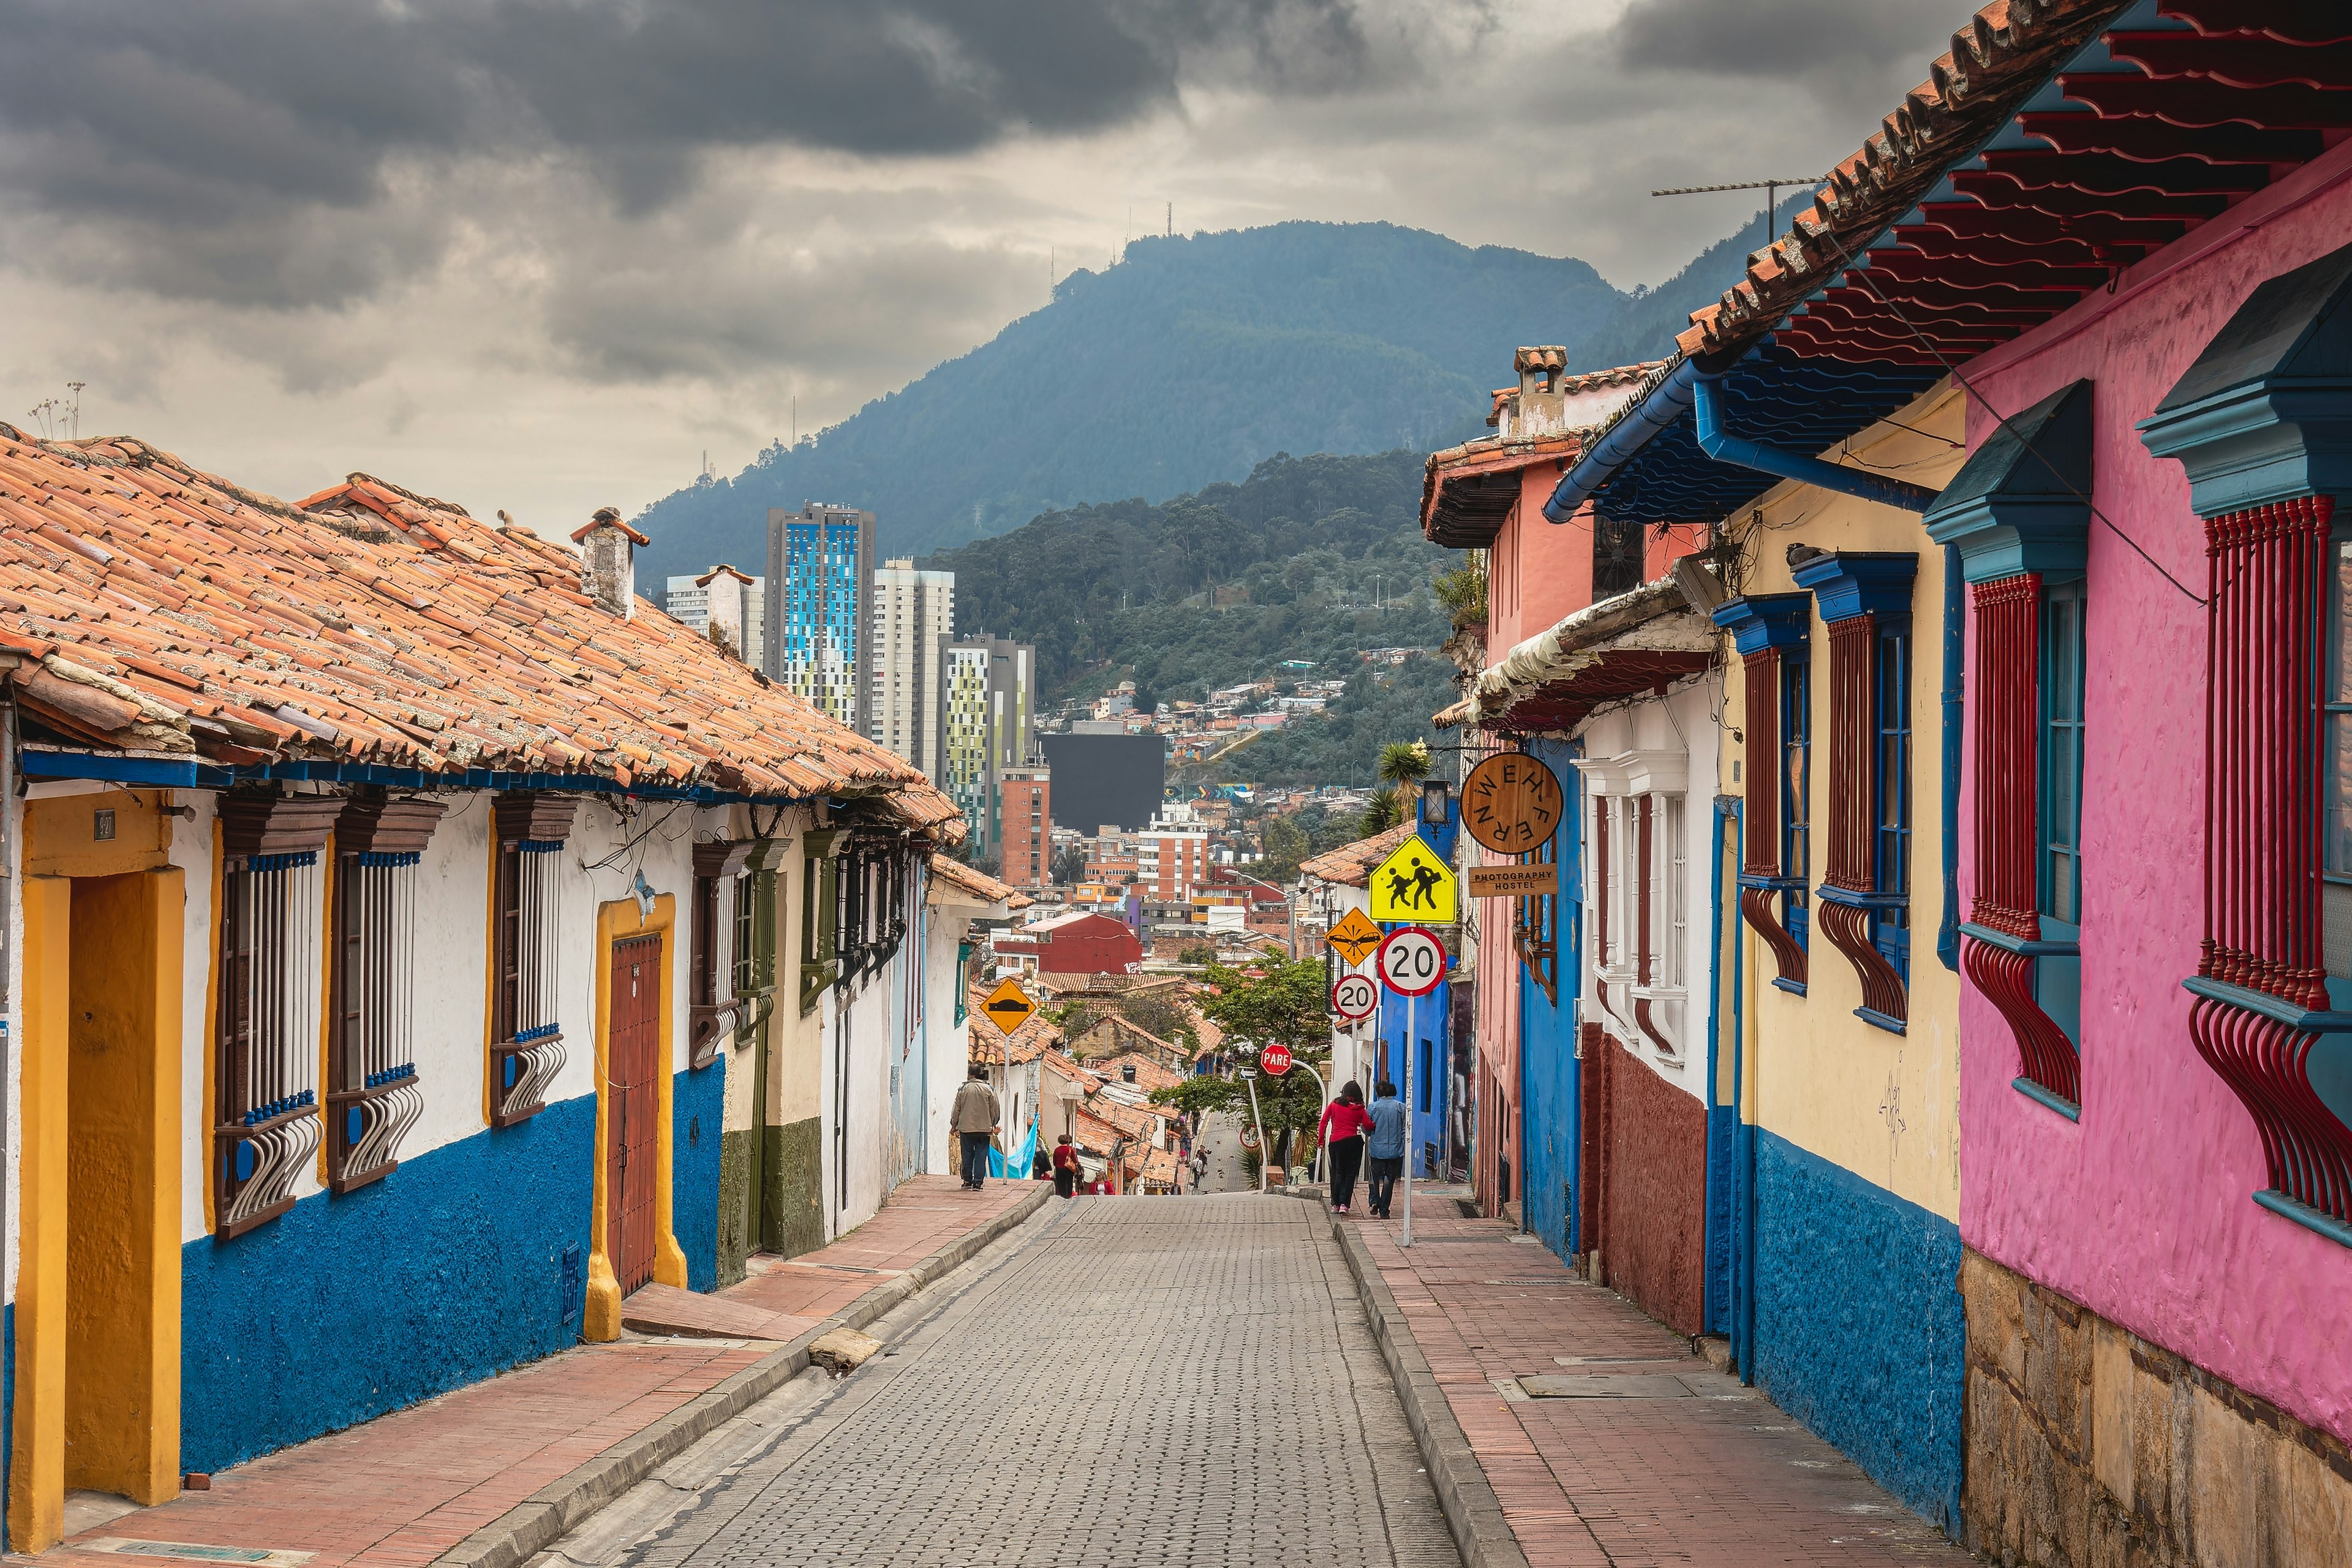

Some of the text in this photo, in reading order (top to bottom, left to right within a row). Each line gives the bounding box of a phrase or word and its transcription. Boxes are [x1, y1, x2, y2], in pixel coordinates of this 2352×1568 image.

[1474, 871, 1552, 881] PHOTOGRAPHY
[1495, 881, 1535, 890] HOSTEL
[1391, 945, 1434, 978] 20
[1340, 986, 1369, 1007] 20
[1264, 1052, 1289, 1066] PARE
